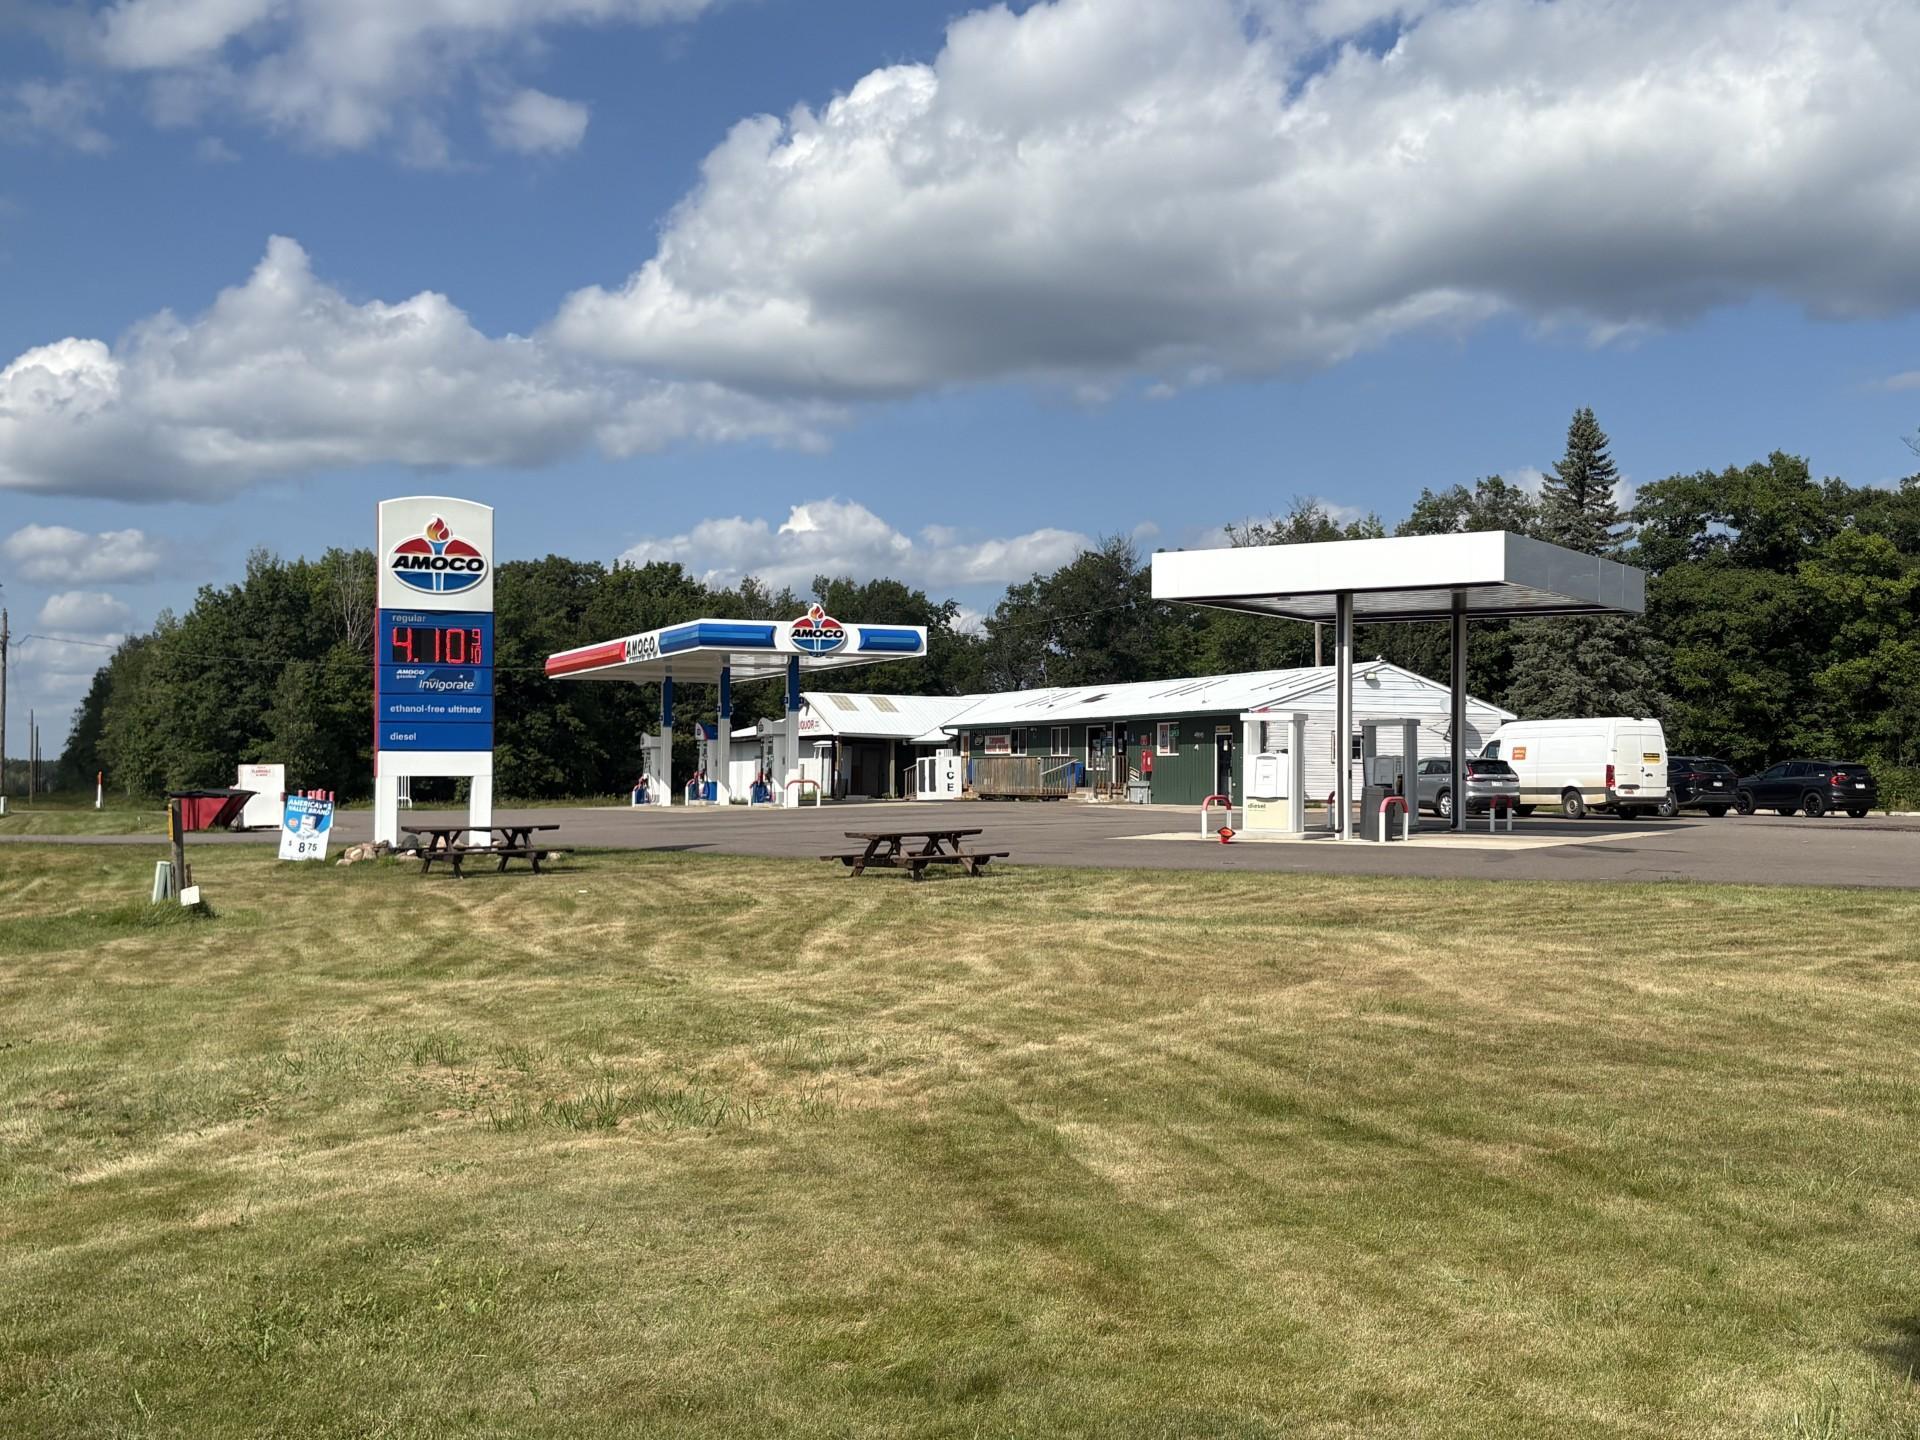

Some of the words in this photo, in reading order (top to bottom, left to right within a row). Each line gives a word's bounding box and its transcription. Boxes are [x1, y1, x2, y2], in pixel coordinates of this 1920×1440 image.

[391, 555, 485, 572] AMOCO
[392, 614, 427, 624] regular
[790, 629, 844, 638] AMOCO
[392, 627, 465, 664] 4.10
[626, 636, 655, 657] AMOCO
[419, 680, 475, 692] Invigorate
[390, 704, 445, 713] ethanol-free
[448, 705, 482, 714] ultimate
[390, 732, 417, 741] diesel
[946, 759, 955, 792] ICE
[308, 808, 330, 816] BRAND
[298, 842, 306, 853] 8
[308, 843, 318, 852] 75
